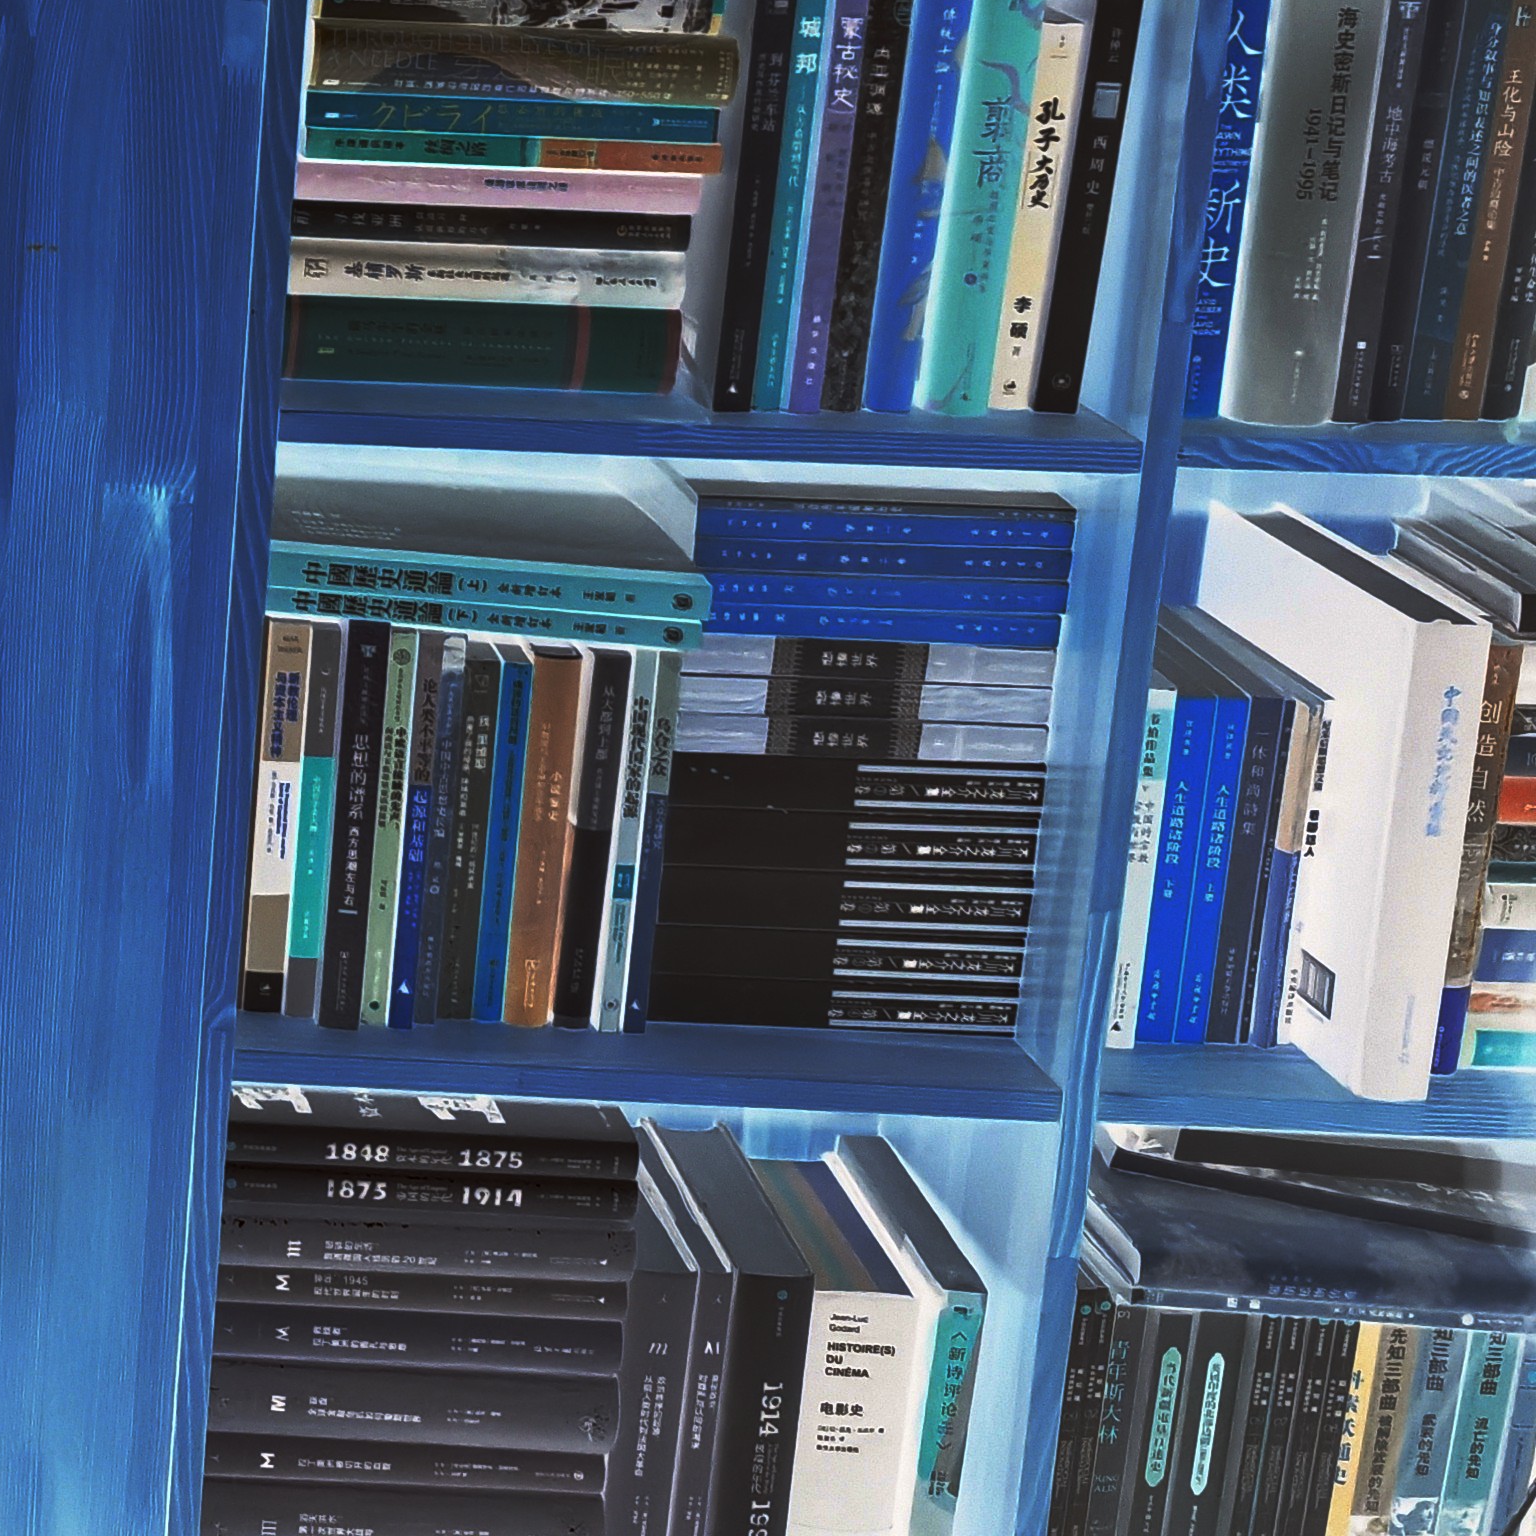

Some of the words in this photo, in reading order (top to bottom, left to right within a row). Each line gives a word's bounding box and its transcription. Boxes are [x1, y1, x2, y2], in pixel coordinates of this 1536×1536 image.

[795, 16, 822, 74] 城邦
[831, 15, 864, 110] 蒙古秘史
[372, 100, 493, 133] クビライ
[1318, 5, 1360, 215] 海史密斯日记与笔记
[1492, 68, 1523, 168] 王化与山险
[1027, 97, 1067, 210] 孔子大历史
[1091, 134, 1113, 197] 西周史
[1378, 104, 1404, 185] 地中海考古
[1007, 294, 1032, 342] 李硕
[658, 718, 679, 789] 乌合之众
[1466, 698, 1501, 824] 创造自然
[409, 790, 432, 863] 起源和基础
[1164, 780, 1189, 865] 人生道路诸阶段
[1205, 784, 1231, 869] 人生道路诸阶段
[325, 1142, 390, 1163] 1848
[457, 1149, 523, 1170] 1875
[326, 1179, 388, 1201] 1875
[461, 1186, 523, 1208] 1914
[825, 1354, 844, 1365] DU
[826, 1341, 896, 1357] HISTOIRE(S)
[828, 1323, 861, 1334] Godard
[824, 1364, 870, 1380] CINÉMA
[1097, 1340, 1131, 1446] 青年斯大林
[1378, 1328, 1406, 1413] 先知三部曲
[758, 1381, 785, 1437] 1914
[820, 1401, 864, 1418] 电影史
